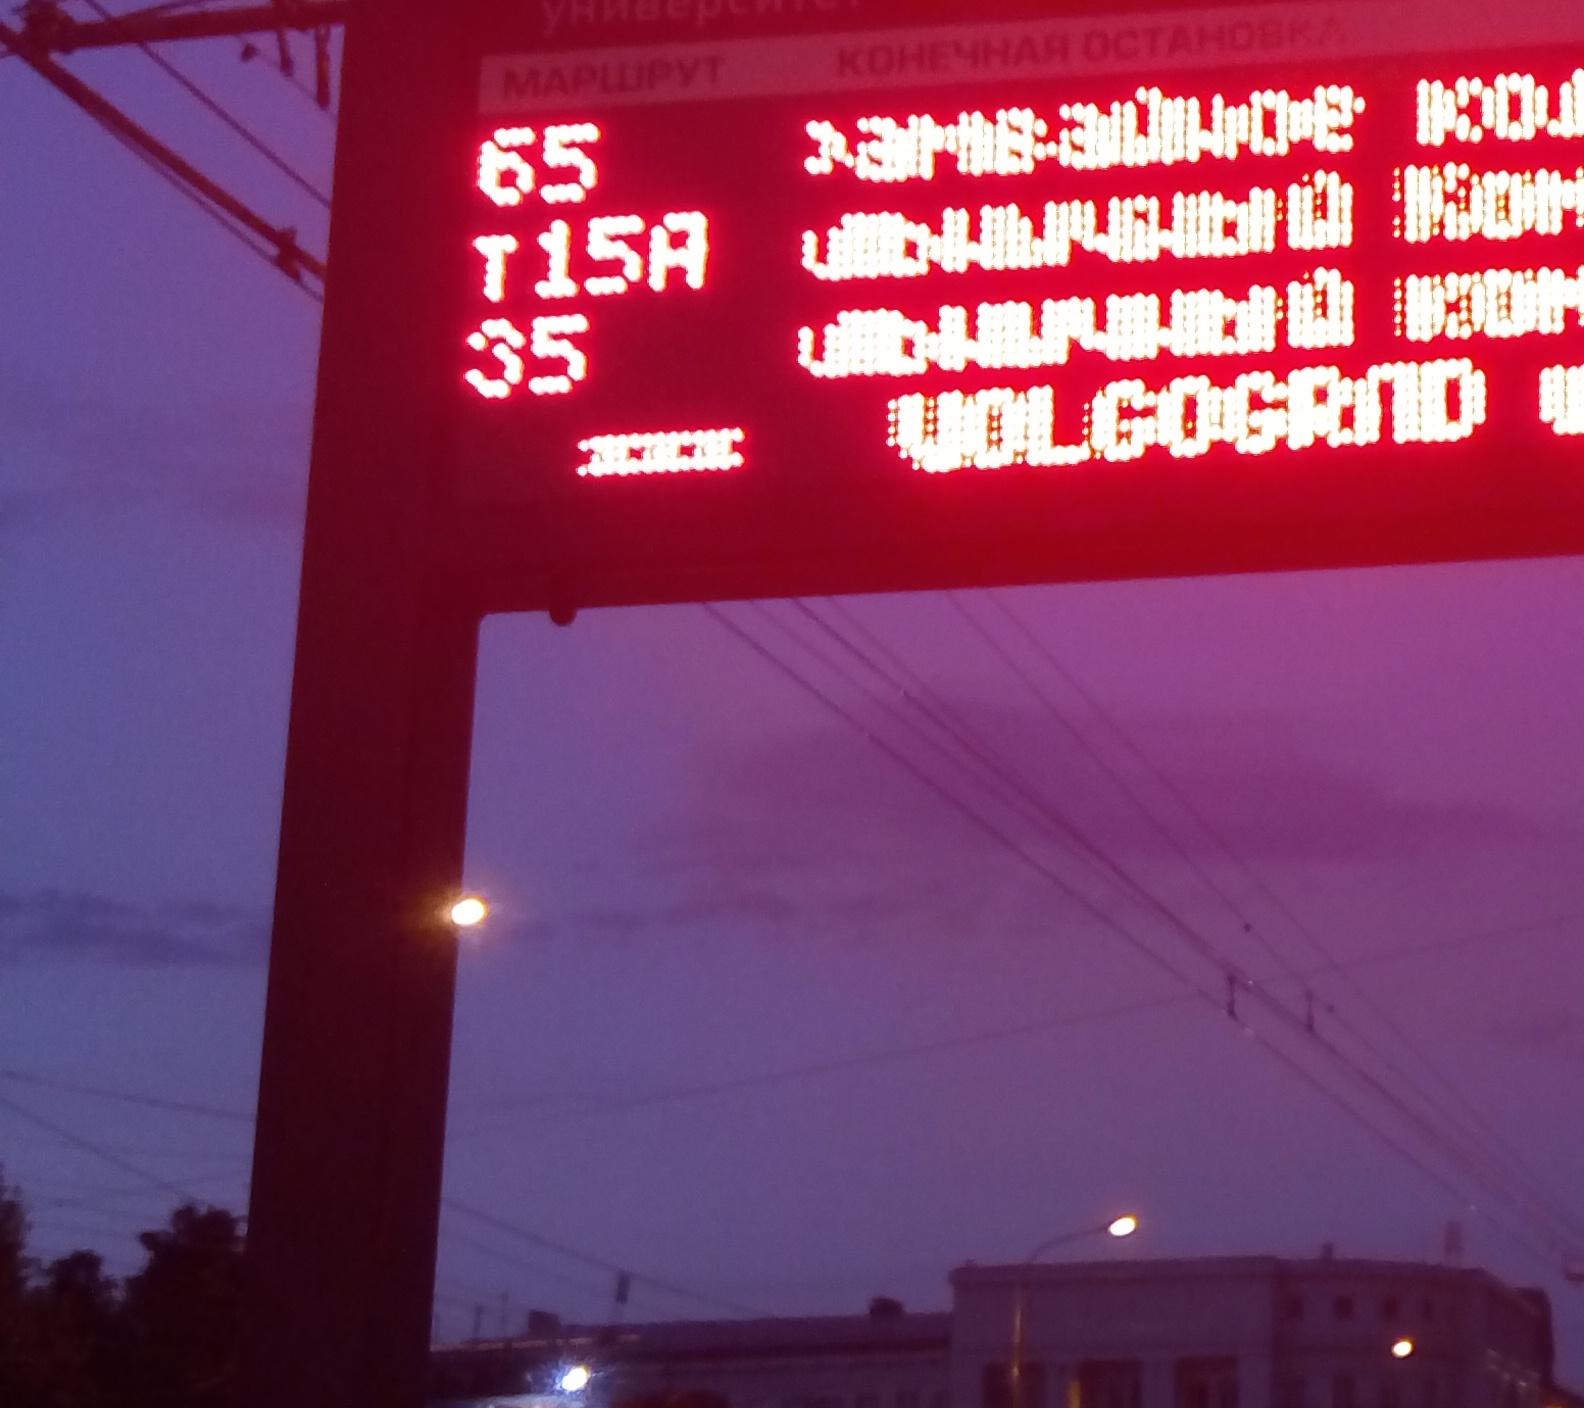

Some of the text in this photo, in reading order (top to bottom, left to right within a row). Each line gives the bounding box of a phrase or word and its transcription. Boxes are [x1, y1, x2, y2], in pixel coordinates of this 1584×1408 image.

[501, 53, 727, 101] МАРШРУТ
[836, 16, 1350, 80] КОНЕЧНАЯ ОСТАНОВКА
[477, 122, 601, 208] 65
[465, 312, 590, 399] 35
